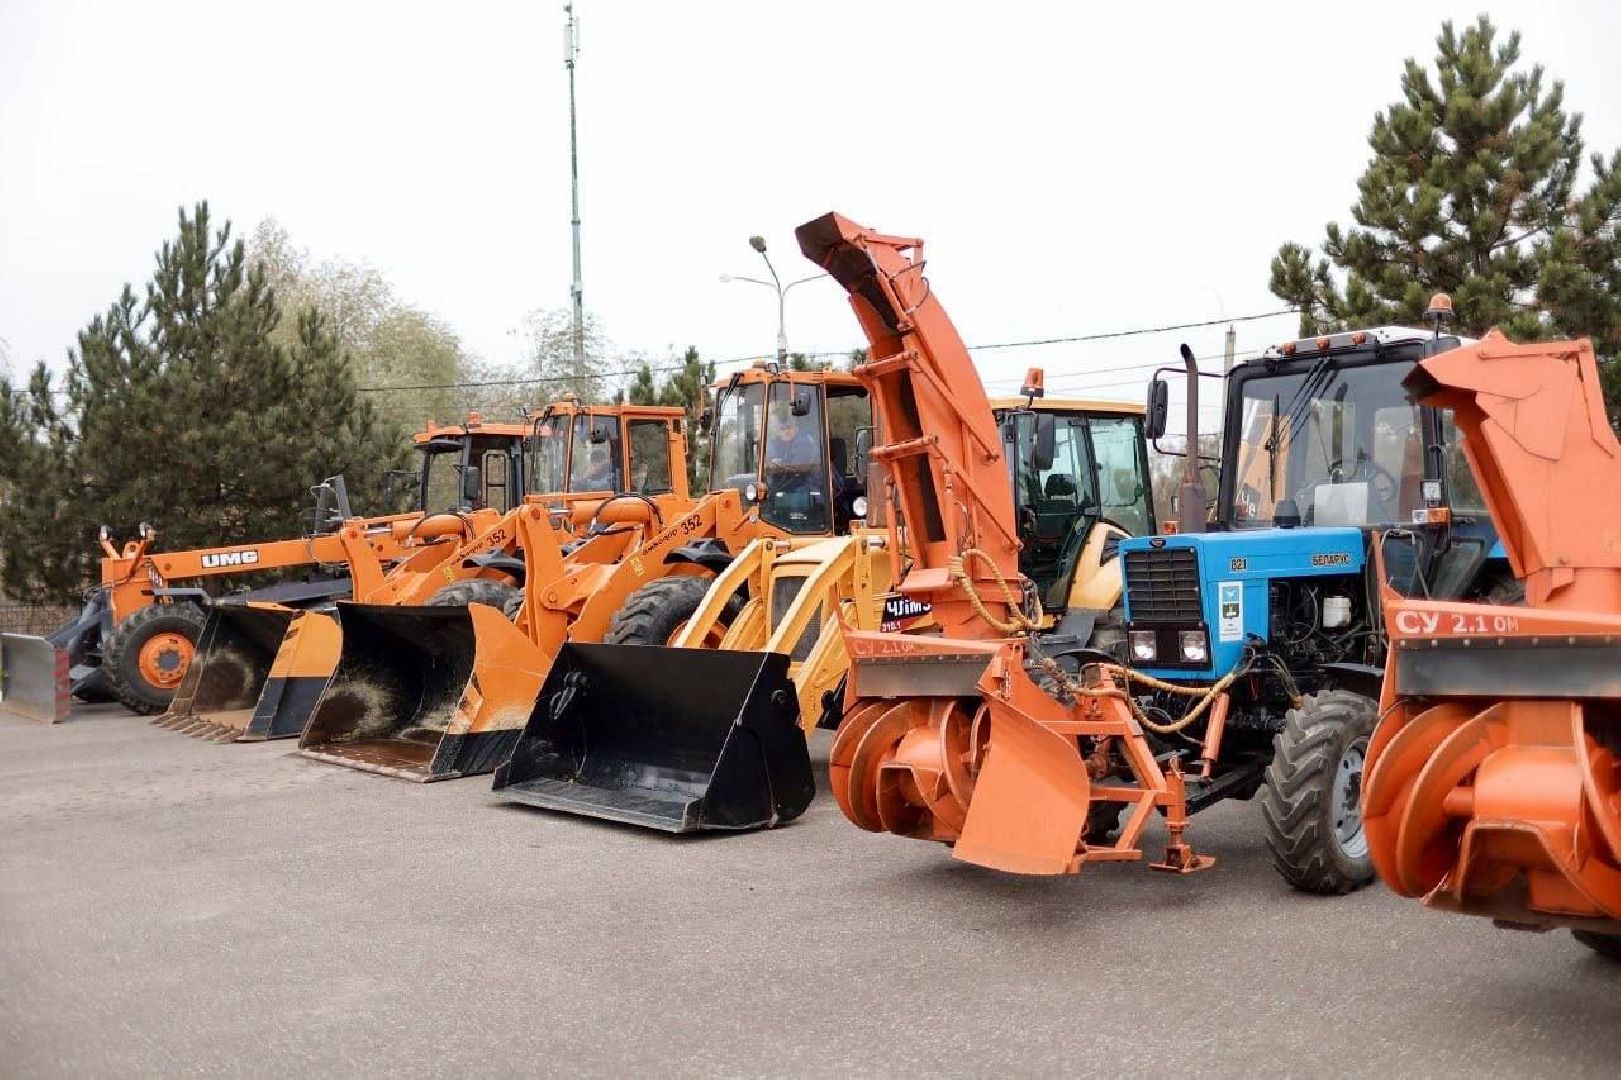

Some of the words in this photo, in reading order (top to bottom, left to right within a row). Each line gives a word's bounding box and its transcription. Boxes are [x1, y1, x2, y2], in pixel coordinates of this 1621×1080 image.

[681, 514, 703, 535] 352
[486, 529, 507, 547] 352
[201, 551, 258, 568] UMG
[1395, 610, 1440, 634] СУ
[1451, 614, 1488, 632] 2.1
